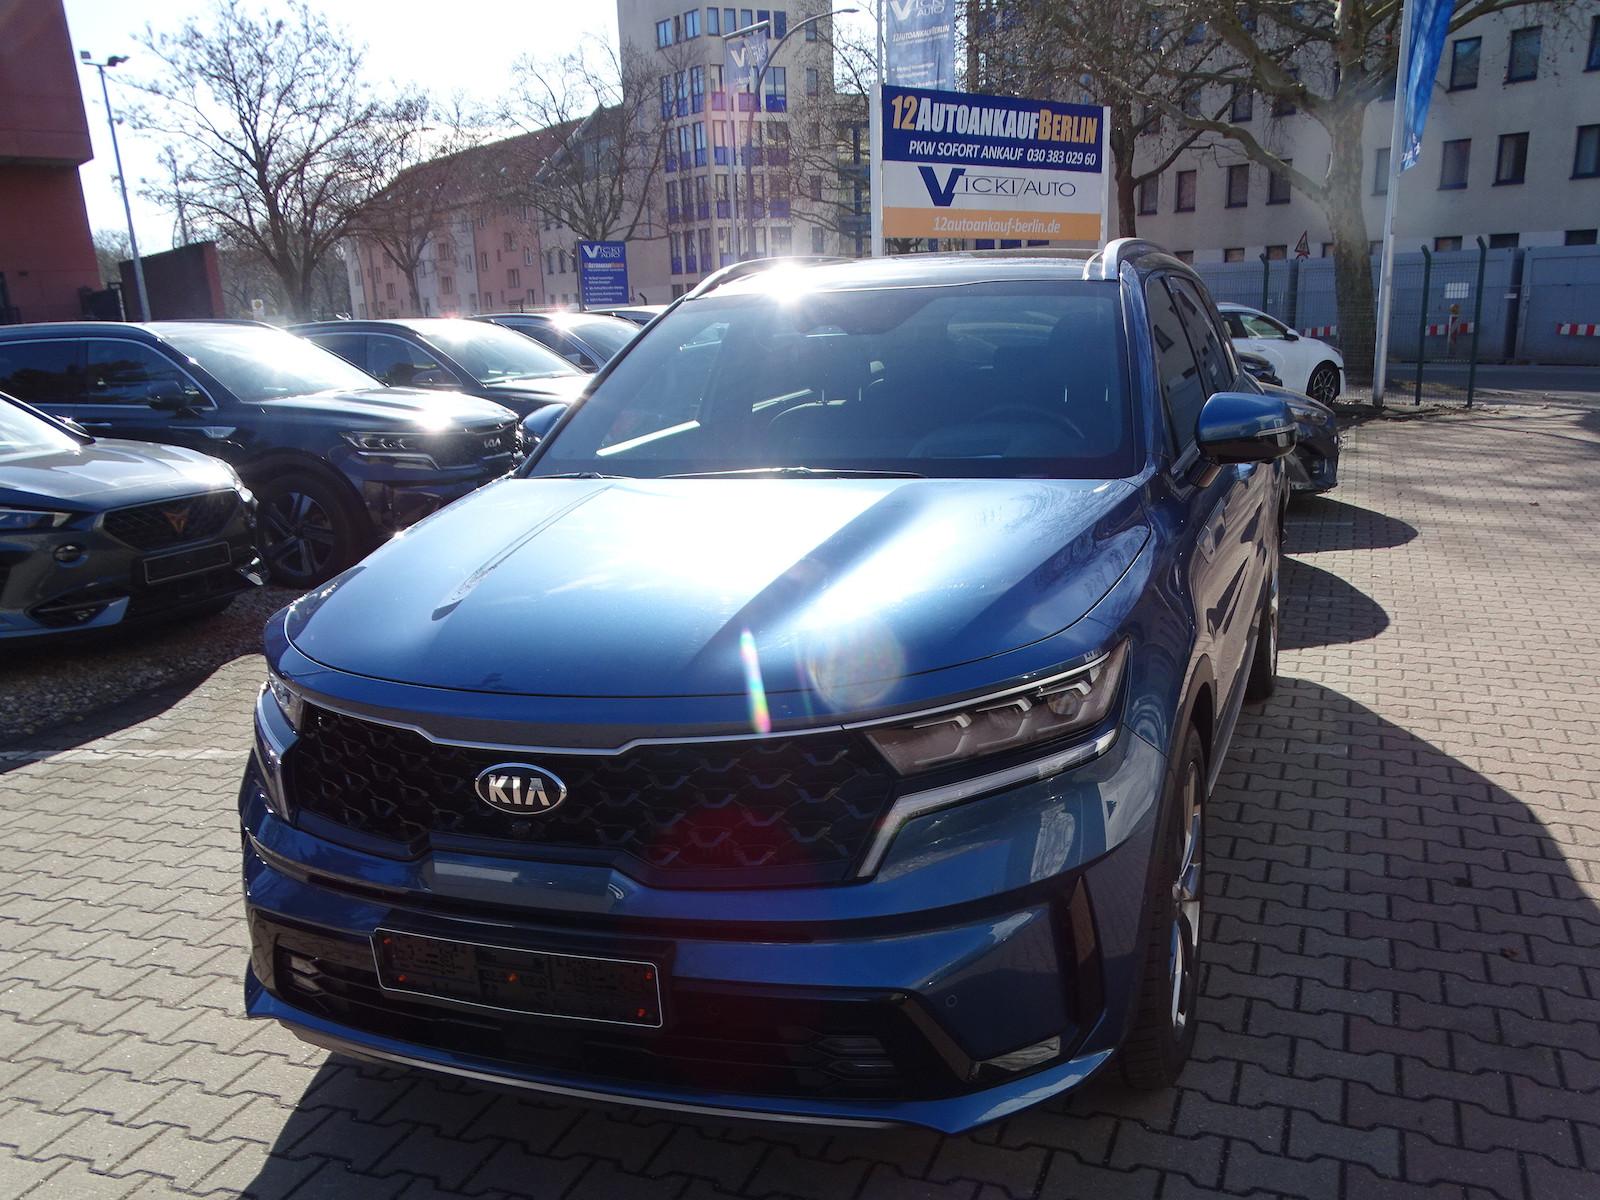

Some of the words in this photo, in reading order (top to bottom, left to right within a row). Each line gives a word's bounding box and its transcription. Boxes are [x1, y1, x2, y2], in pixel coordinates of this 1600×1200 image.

[909, 140, 936, 156] PKW
[937, 142, 980, 159] SOFORT
[981, 145, 1024, 161] ANKAUF
[1027, 148, 1047, 163] 030
[1047, 149, 1065, 164] 383
[1065, 151, 1083, 165] 029
[1084, 152, 1096, 165] 60
[932, 216, 1061, 235] 12autoankauf-berlin.de
[488, 774, 551, 807] KIA
